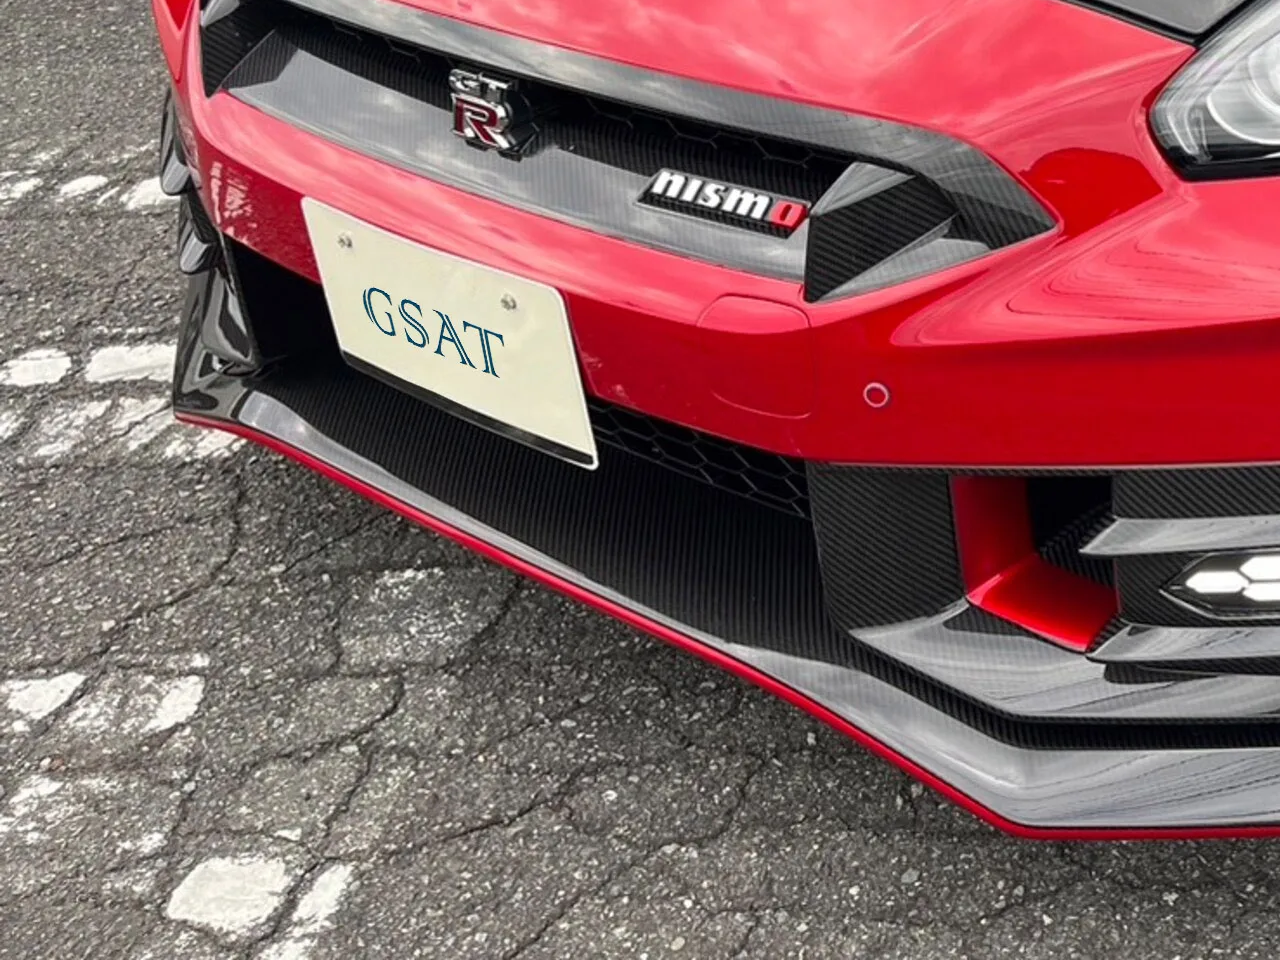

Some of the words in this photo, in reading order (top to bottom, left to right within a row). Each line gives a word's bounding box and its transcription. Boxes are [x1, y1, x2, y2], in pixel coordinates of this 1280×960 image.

[451, 93, 513, 151] R
[651, 171, 808, 229] nismo
[363, 287, 505, 379] GSAT
